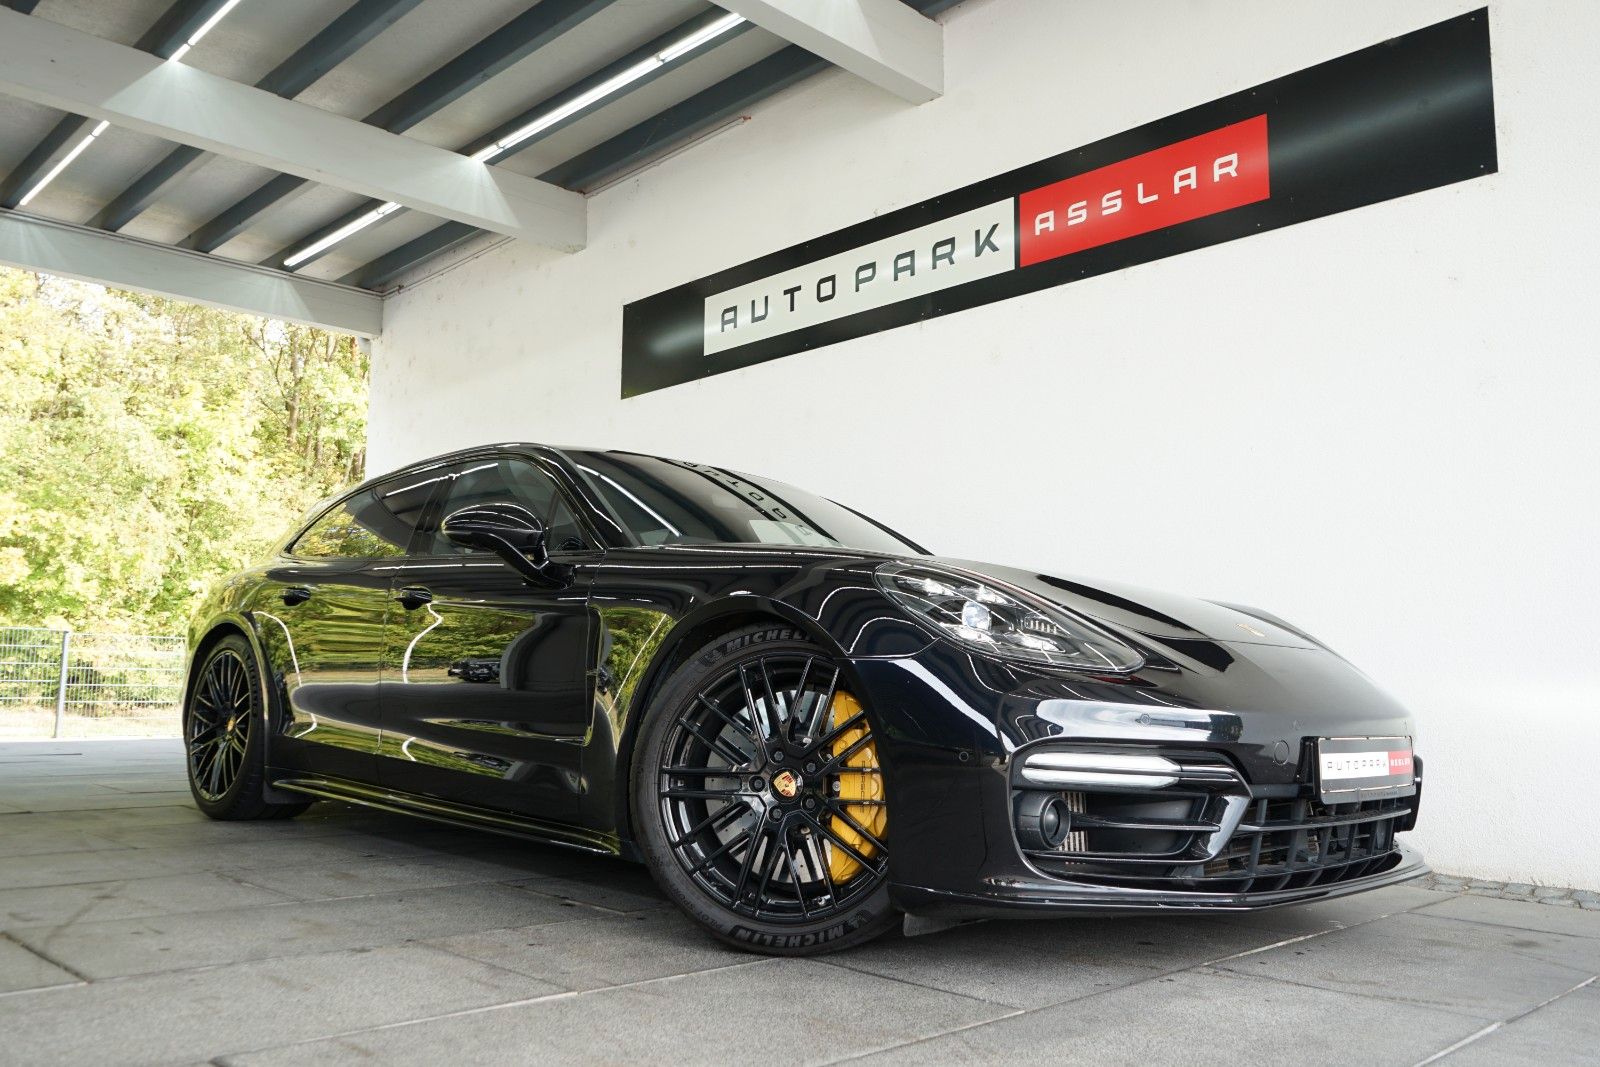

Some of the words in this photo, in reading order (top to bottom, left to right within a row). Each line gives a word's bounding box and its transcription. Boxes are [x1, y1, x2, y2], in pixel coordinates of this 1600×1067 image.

[720, 223, 1000, 332] AUTOPARK
[1035, 153, 1238, 235] ASSLAR
[726, 629, 810, 652] MICHELI
[736, 926, 845, 947] MICHELIN
